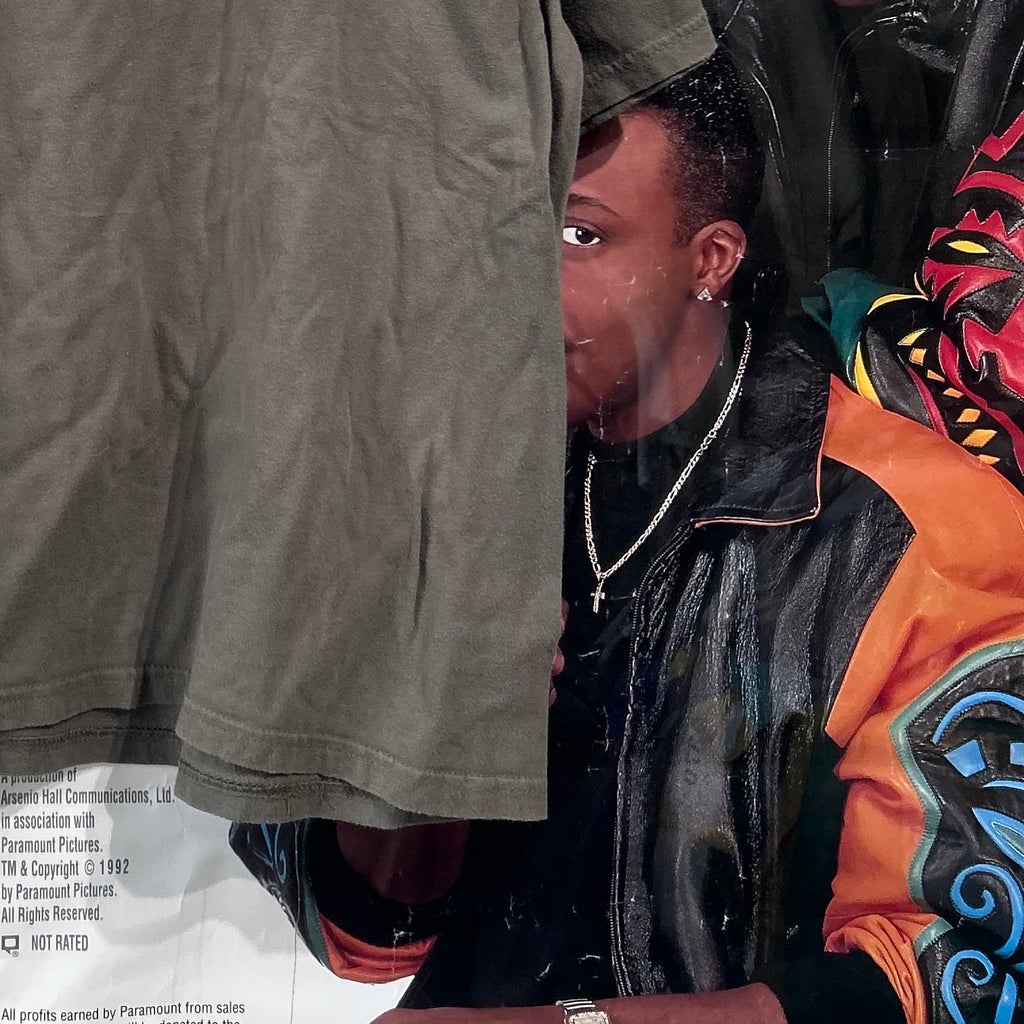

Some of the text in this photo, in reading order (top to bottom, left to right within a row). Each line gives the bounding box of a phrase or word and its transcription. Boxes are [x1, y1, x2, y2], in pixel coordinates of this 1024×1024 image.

[67, 767, 78, 783] of
[1, 786, 176, 805] Arsenio Hall Communications, Ltd.
[1, 811, 95, 830] in association with
[1, 836, 103, 854] Paramount Pictures.
[1, 861, 17, 876] TM
[20, 860, 28, 876] &
[31, 860, 79, 879] Copyright
[100, 859, 130, 875] 1992
[1, 883, 118, 903] by Paramount Pictures.
[1, 905, 104, 925] All Rights Reserved.
[31, 934, 89, 952] NOT RATED
[1, 1000, 246, 1024] All profits earned by Paramount from sales
